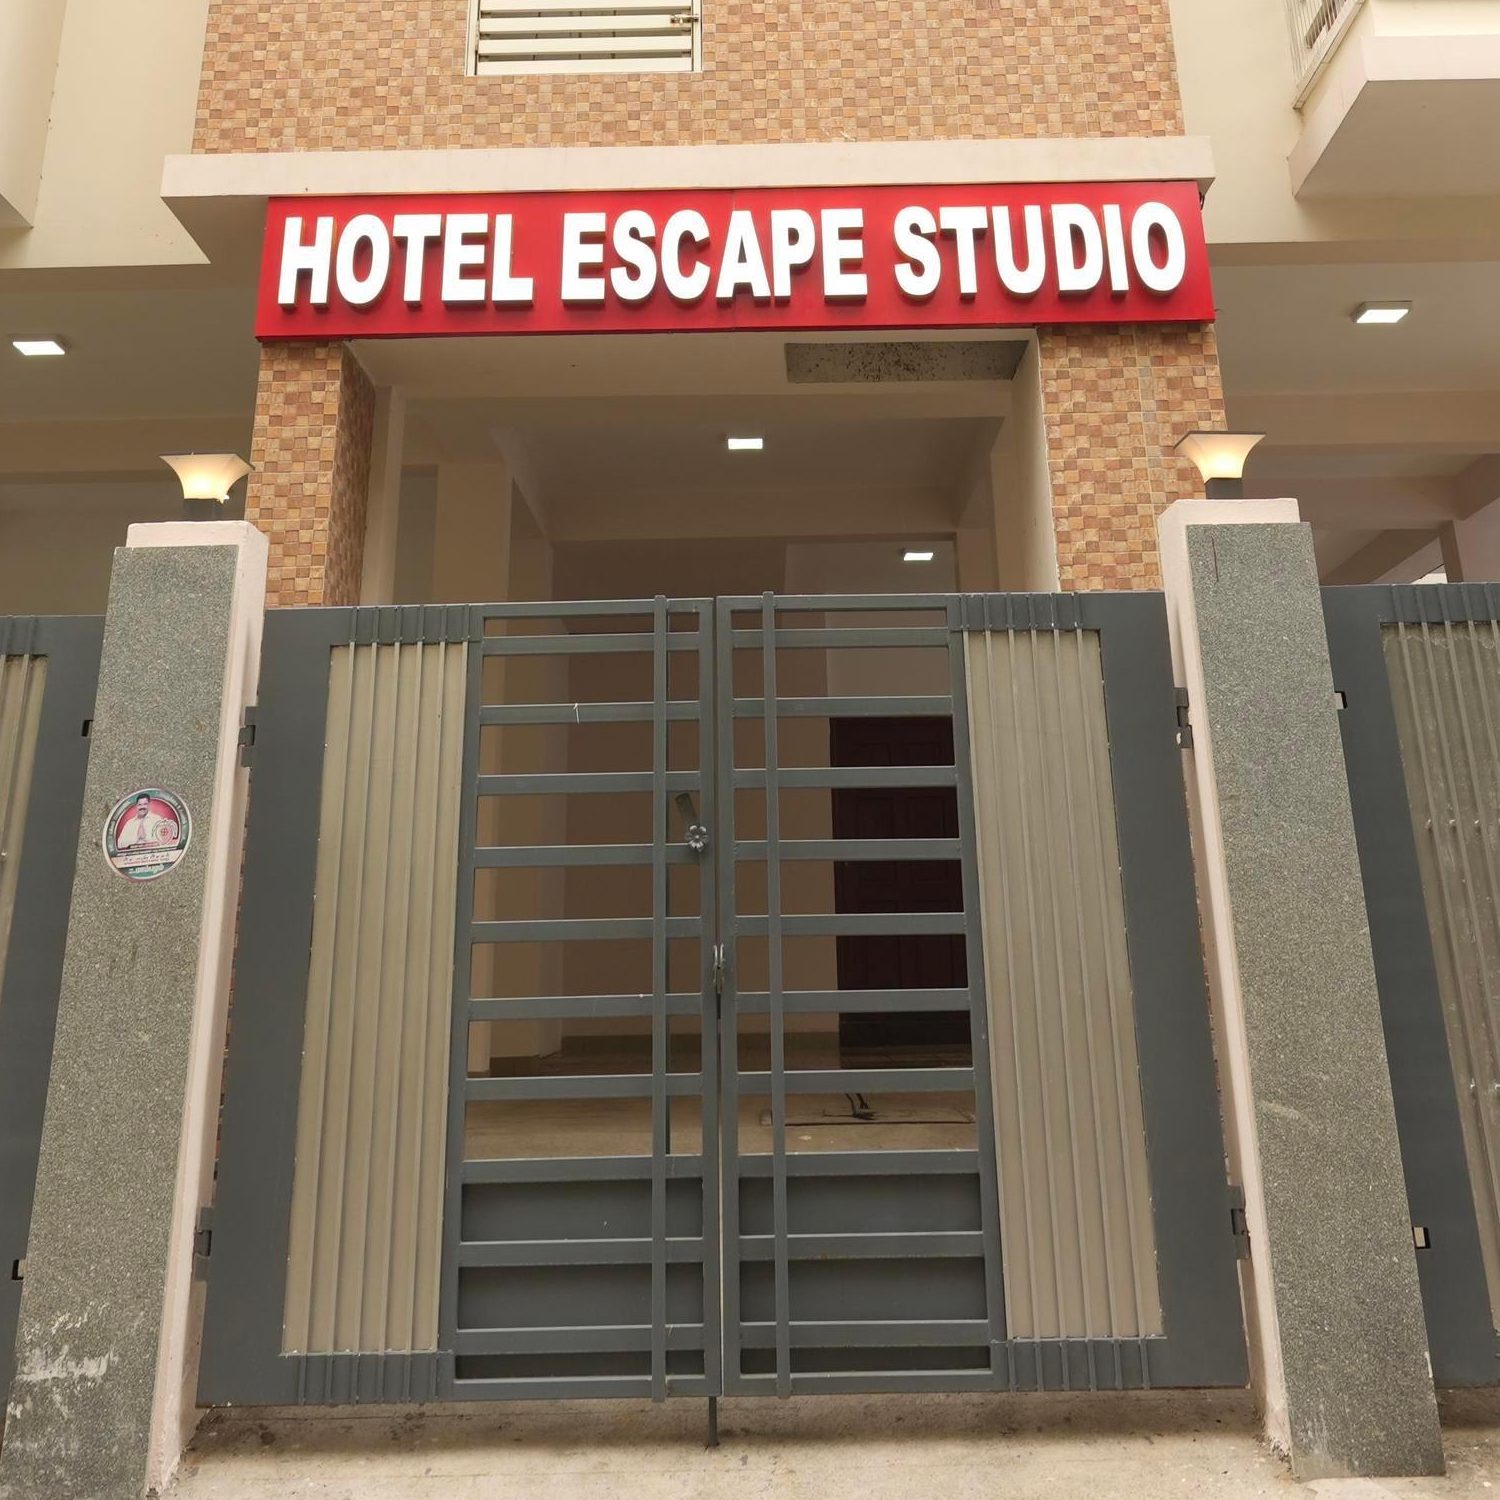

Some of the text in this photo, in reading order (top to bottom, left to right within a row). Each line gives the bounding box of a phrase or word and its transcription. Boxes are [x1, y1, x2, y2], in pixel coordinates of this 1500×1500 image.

[277, 201, 1187, 305] HOTEL ESCAPE STUDIO
